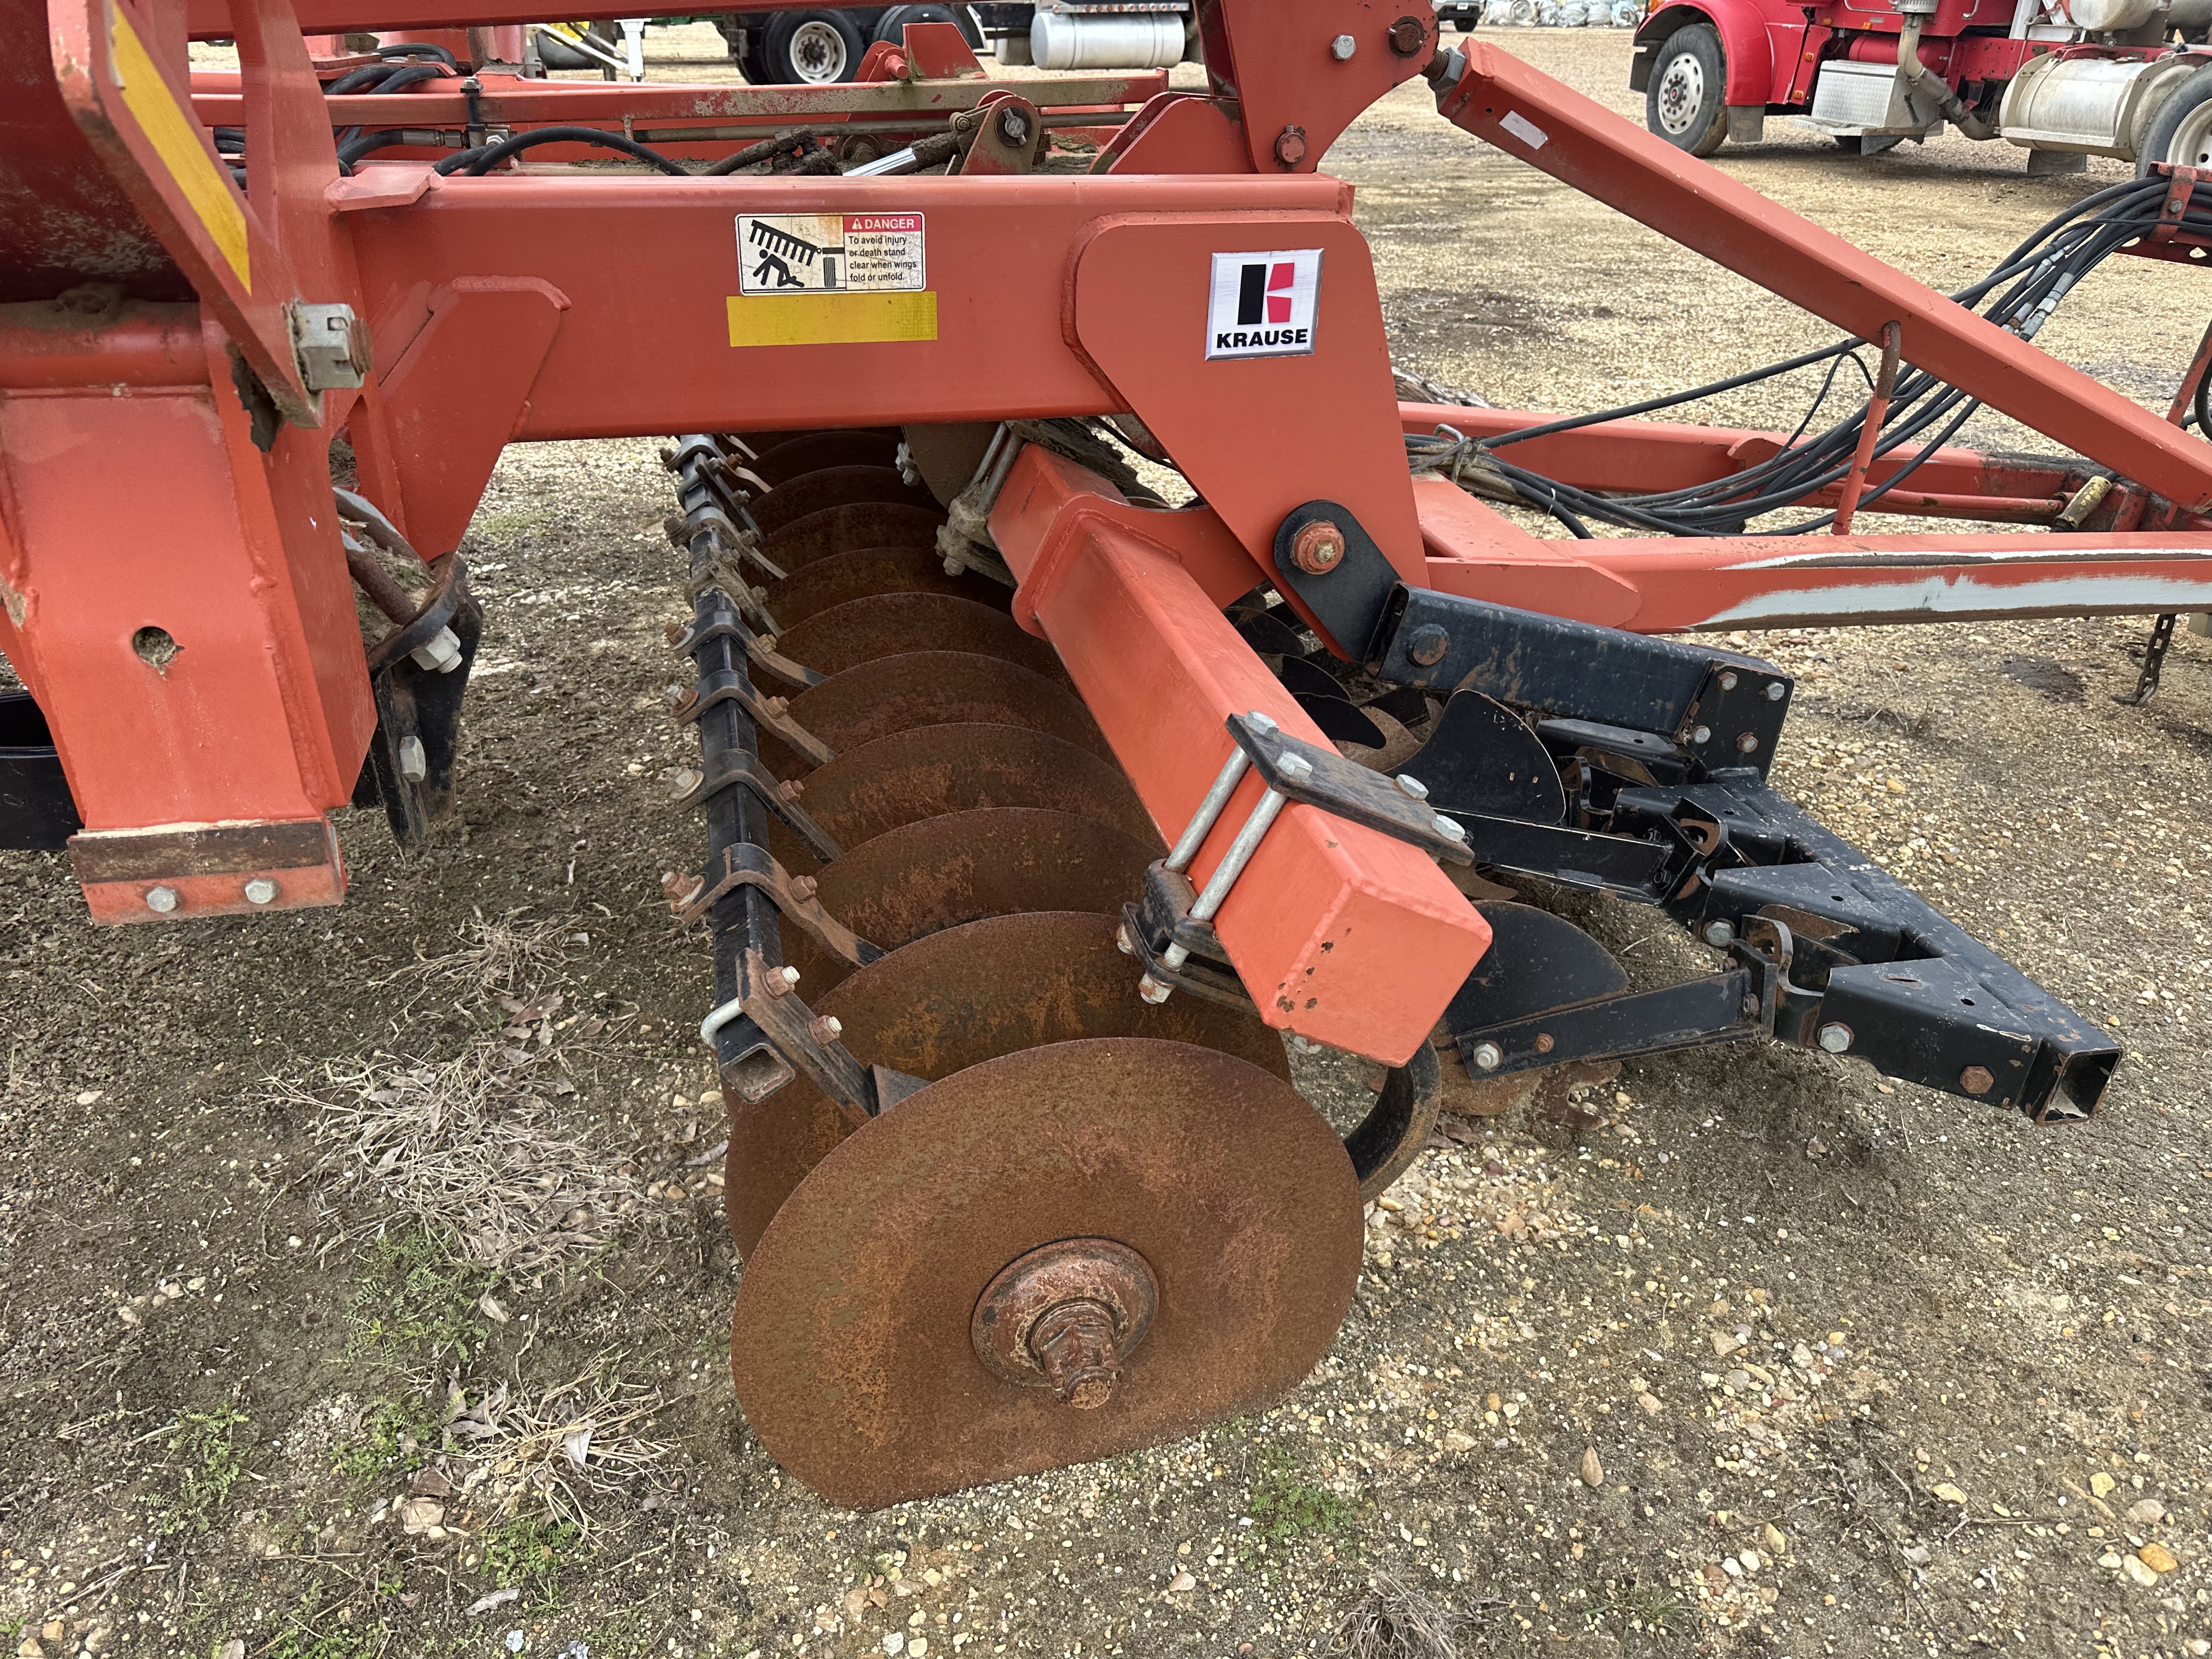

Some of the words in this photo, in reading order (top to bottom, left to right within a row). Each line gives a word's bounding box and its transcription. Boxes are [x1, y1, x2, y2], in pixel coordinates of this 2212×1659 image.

[865, 218, 915, 229] DANGER
[849, 236, 859, 244] To
[861, 235, 882, 244] avoid
[885, 235, 907, 245] injury
[860, 248, 882, 257] death
[883, 248, 905, 256] stand
[871, 261, 892, 269] when
[894, 260, 917, 269] wings
[850, 273, 865, 281] fold
[878, 272, 905, 281] unfold.
[1216, 329, 1308, 348] KRAUSE
